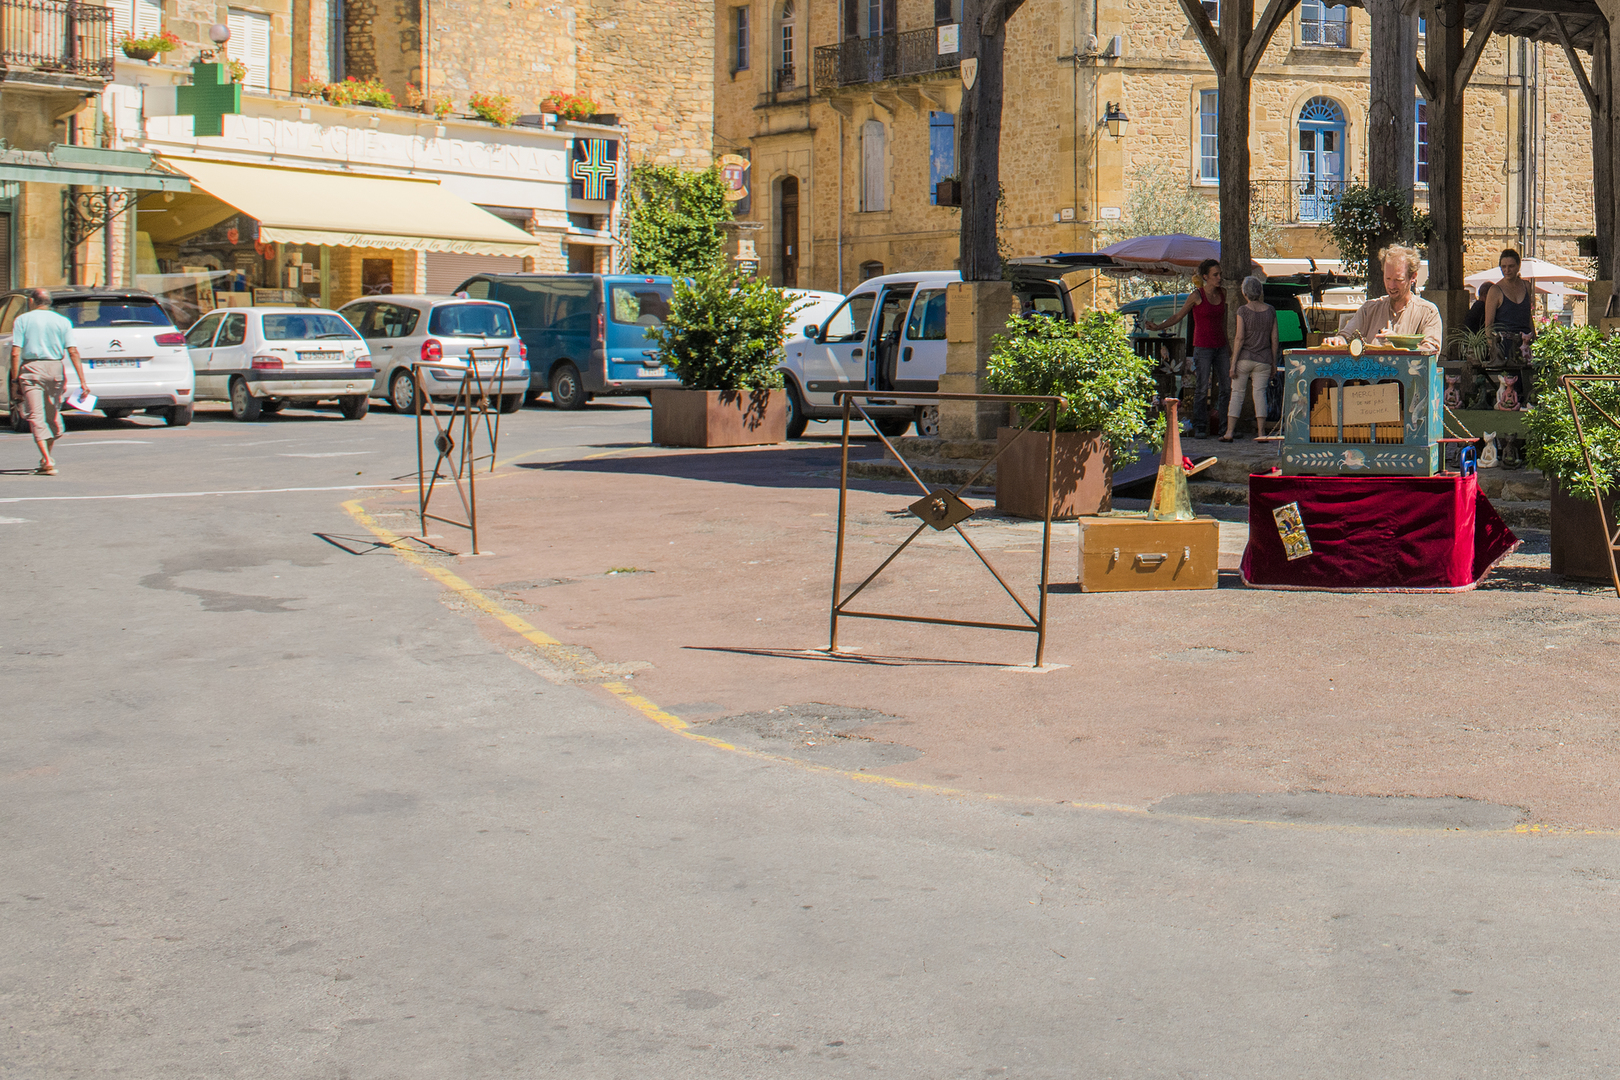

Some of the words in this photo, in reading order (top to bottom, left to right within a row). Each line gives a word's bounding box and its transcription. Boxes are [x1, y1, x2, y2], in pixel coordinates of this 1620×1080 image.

[343, 232, 409, 248] Pharmacie
[412, 238, 425, 249] de
[428, 239, 440, 250] la
[1346, 295, 1367, 304] BA
